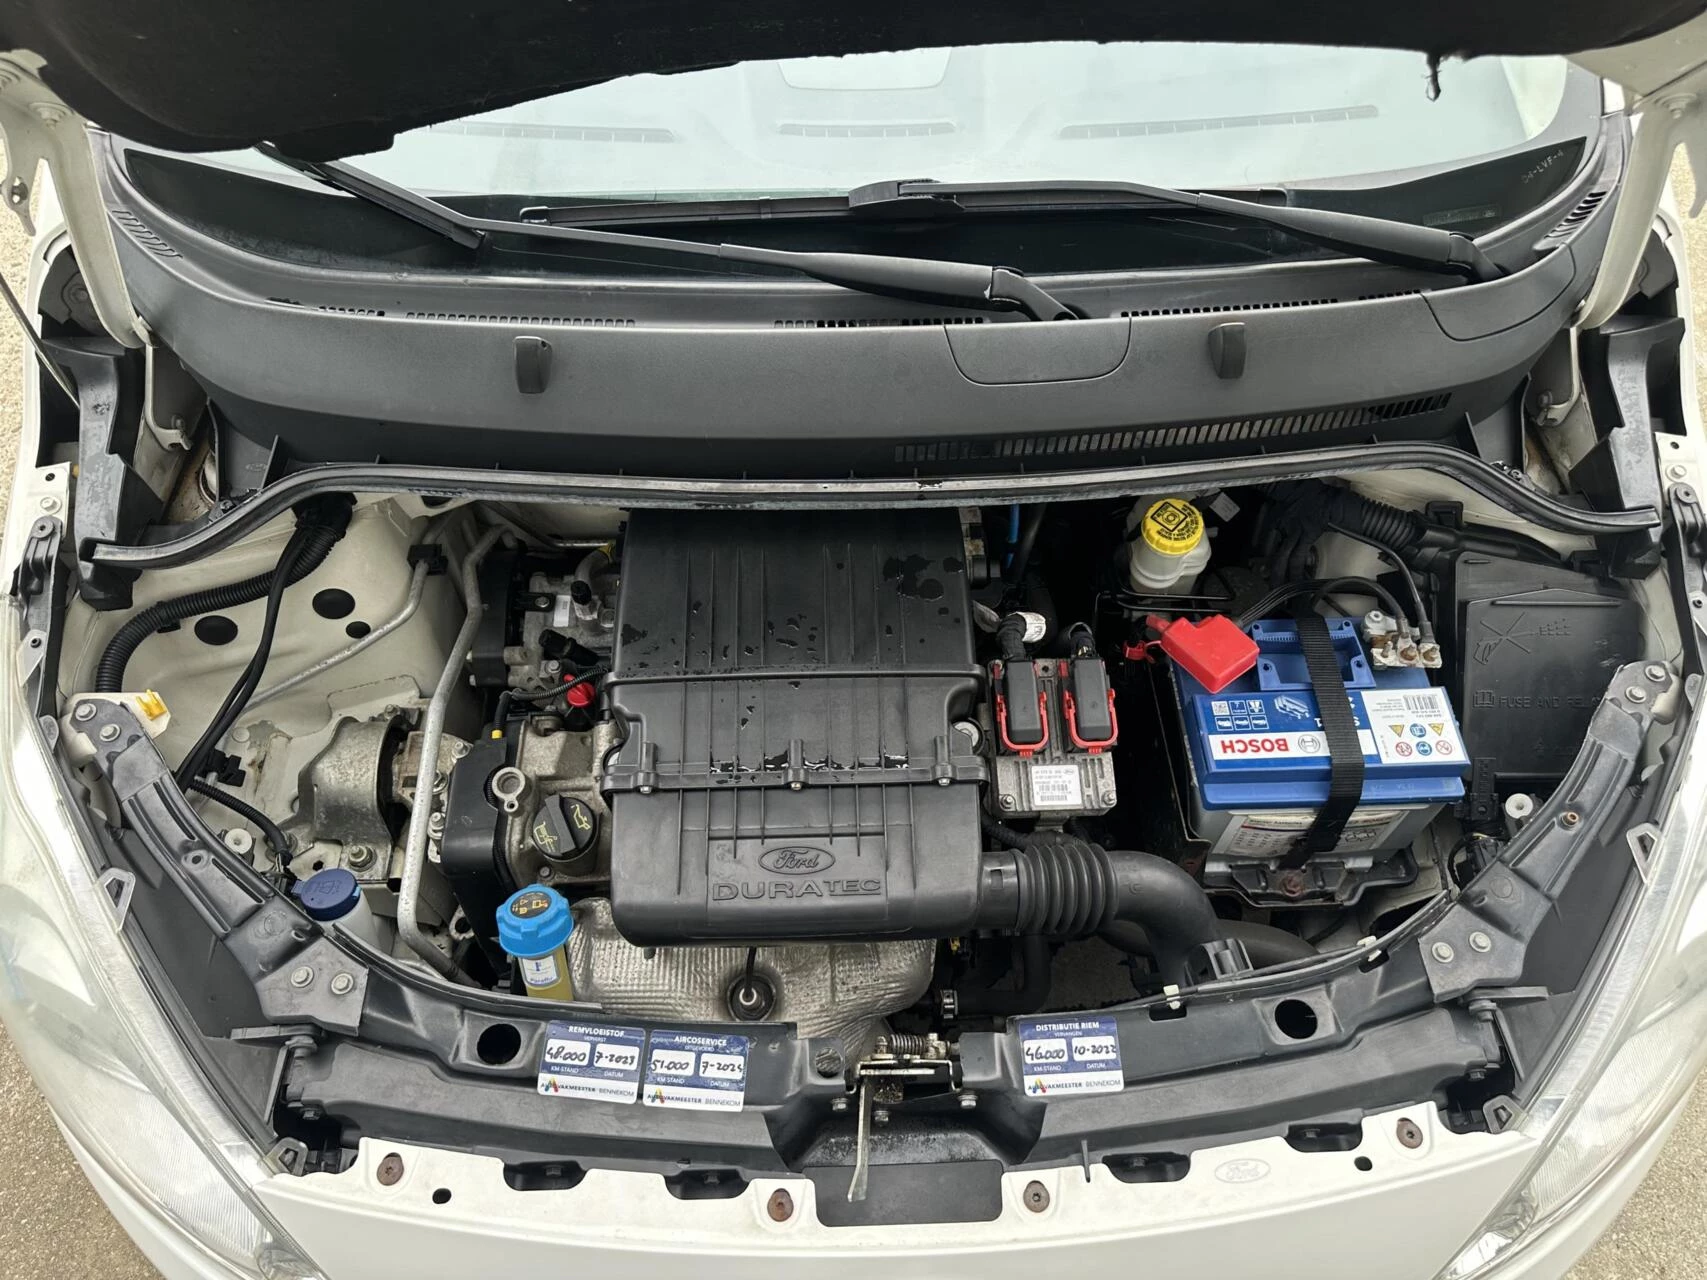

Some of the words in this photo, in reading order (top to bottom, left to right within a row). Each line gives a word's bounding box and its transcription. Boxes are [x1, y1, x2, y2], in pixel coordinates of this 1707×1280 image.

[1499, 696, 1531, 708] FUSE
[1220, 738, 1289, 754] BOSCH
[773, 849, 820, 869] Ford
[712, 879, 881, 901] DURATEC
[568, 1026, 624, 1038] REMVLOEISTOF
[1036, 1022, 1080, 1032] DISTRIBUTIE
[1081, 1021, 1100, 1029] RIEM
[674, 1036, 727, 1046] AIRCOSERVICE
[1085, 1080, 1121, 1088] BENNEKOM
[598, 1086, 635, 1096] BENNEKOM
[704, 1098, 741, 1106] BENNEKOM
